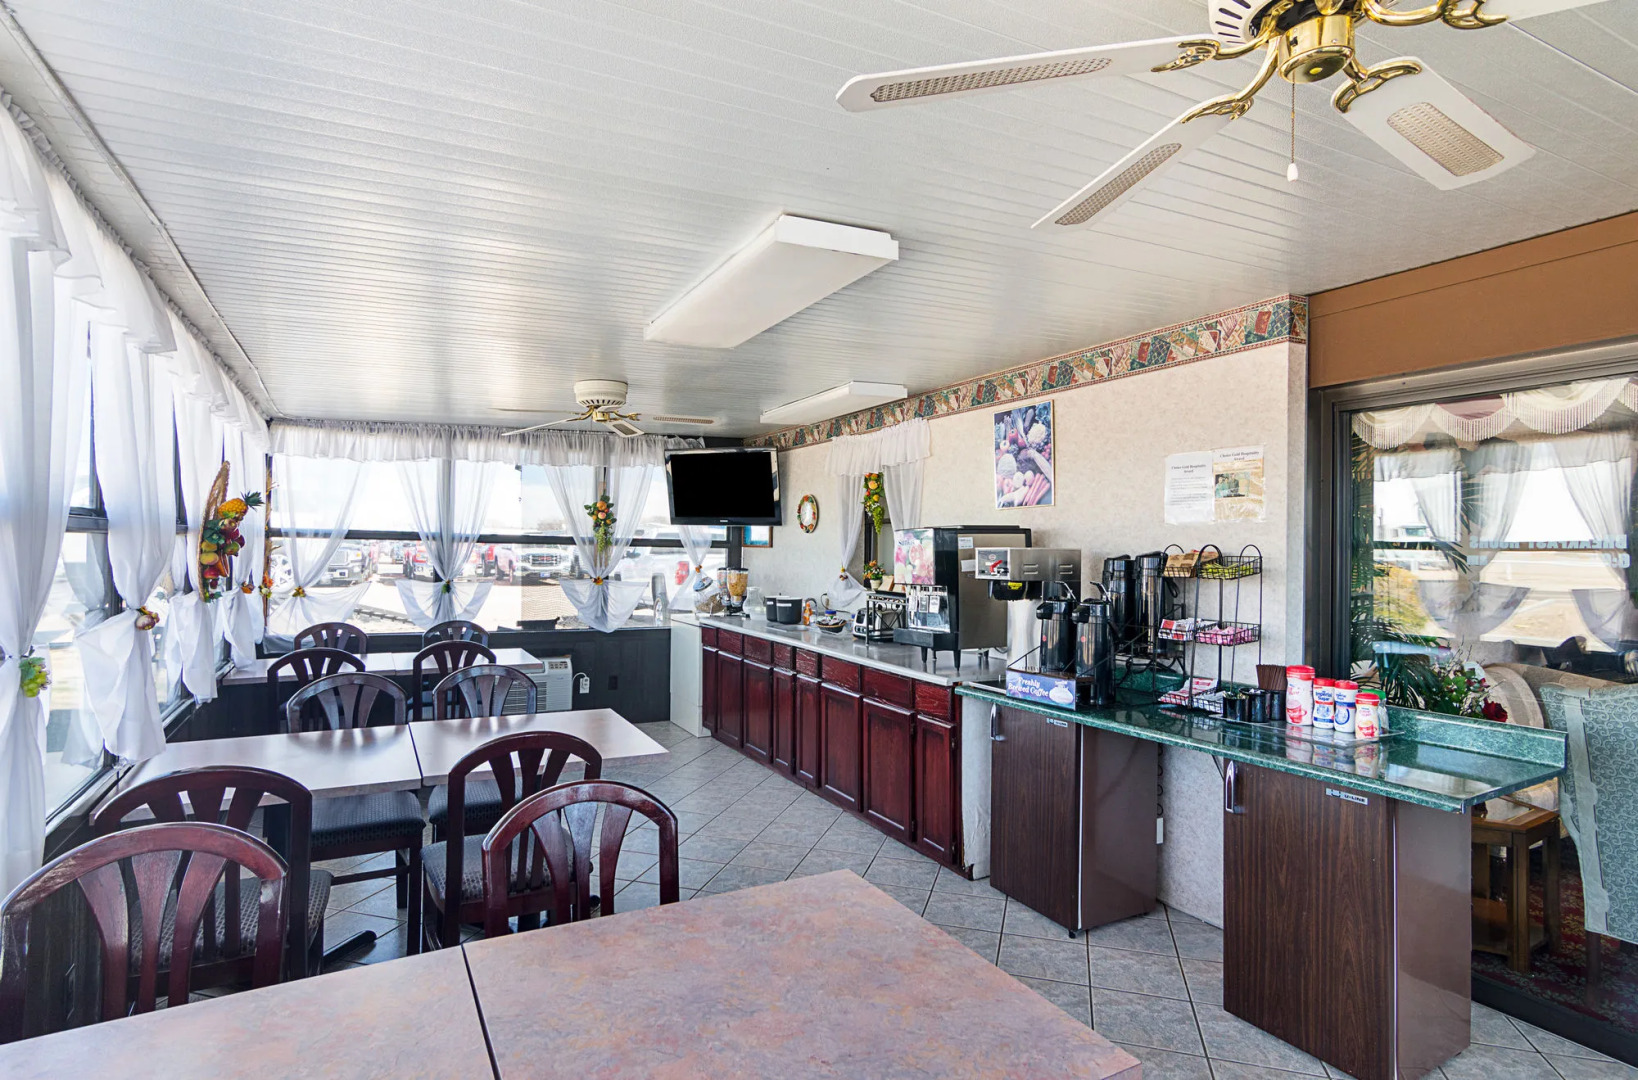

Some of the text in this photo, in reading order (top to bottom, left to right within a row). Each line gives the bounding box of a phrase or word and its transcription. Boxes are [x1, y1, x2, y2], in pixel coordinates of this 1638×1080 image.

[1018, 676, 1040, 688] Freshly
[1008, 682, 1049, 697] Brewed Coffee
[1344, 794, 1366, 803] U-LINE
